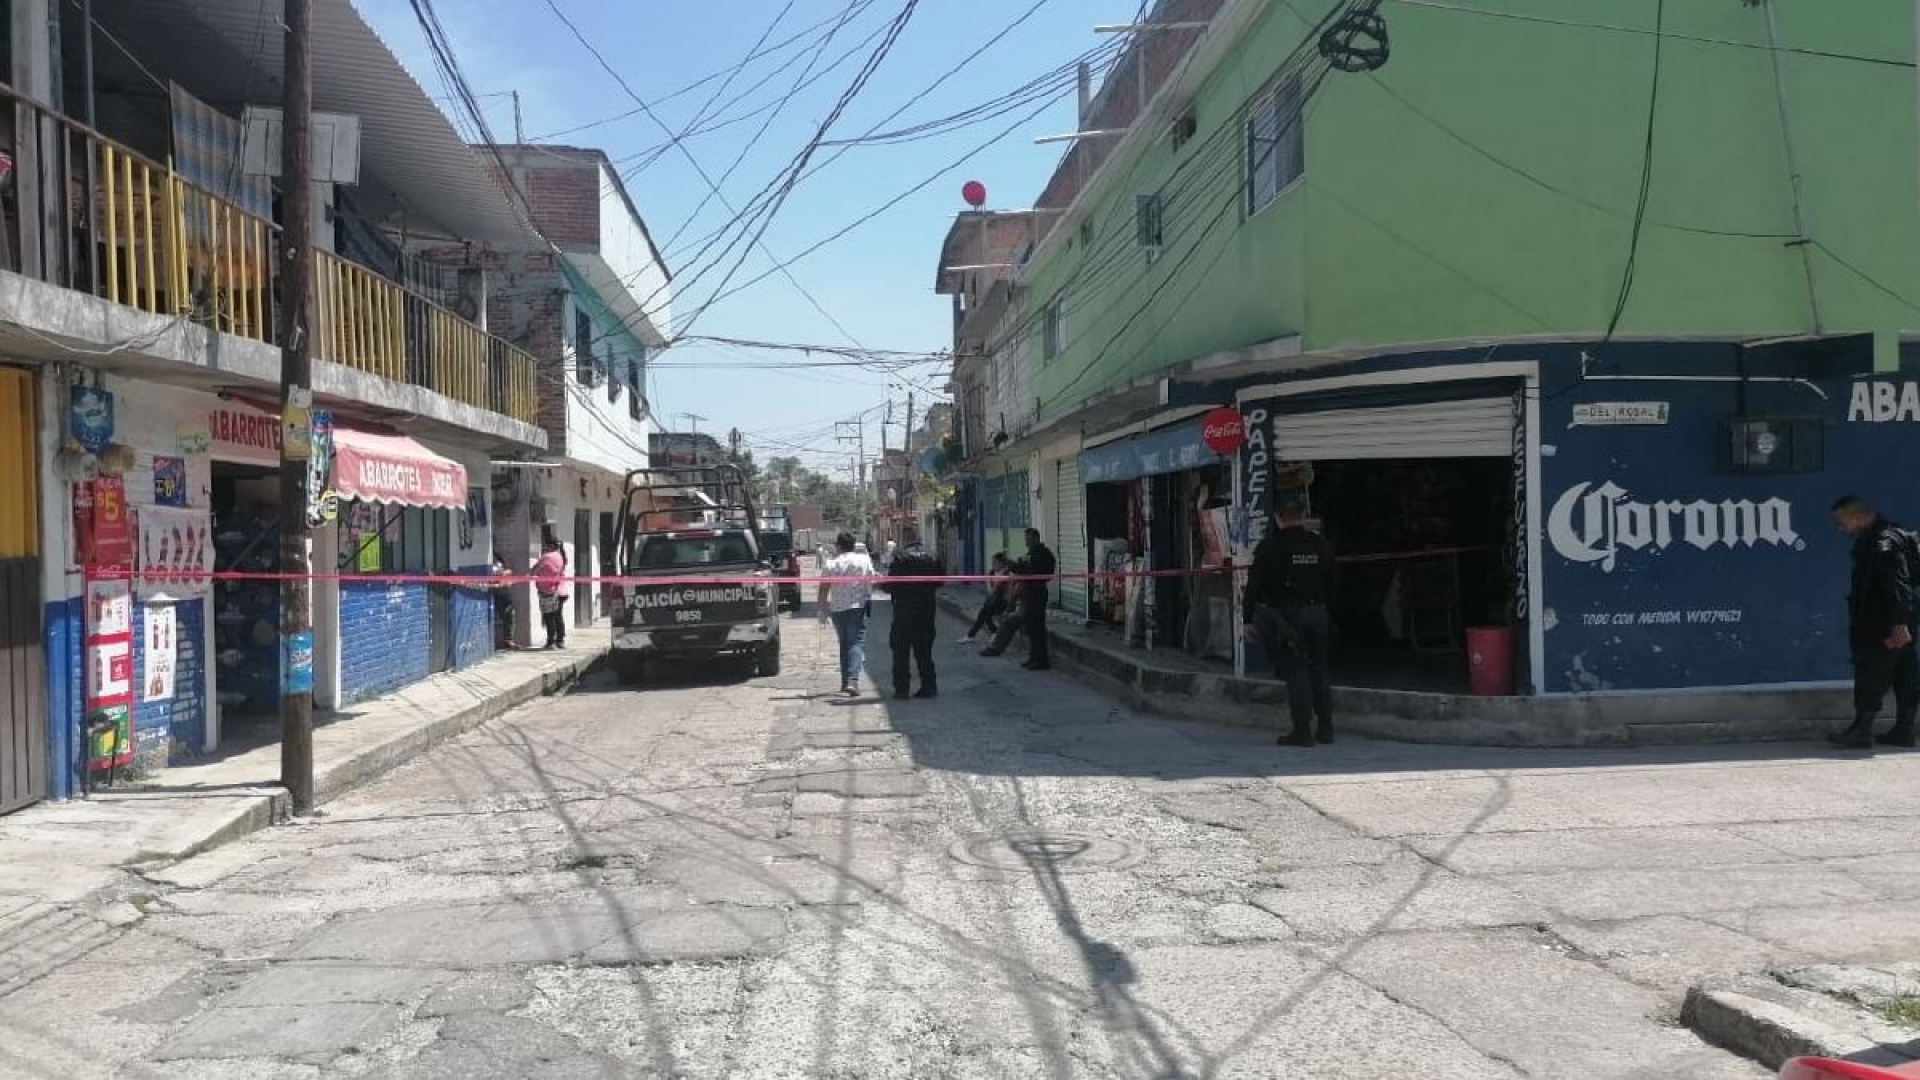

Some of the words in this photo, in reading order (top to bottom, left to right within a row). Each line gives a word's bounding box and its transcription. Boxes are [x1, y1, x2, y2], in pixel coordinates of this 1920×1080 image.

[1847, 381, 1920, 422] ABA
[1548, 480, 1800, 574] Corona
[624, 588, 683, 609] POLICÍA
[696, 587, 756, 604] MUNICIPAL
